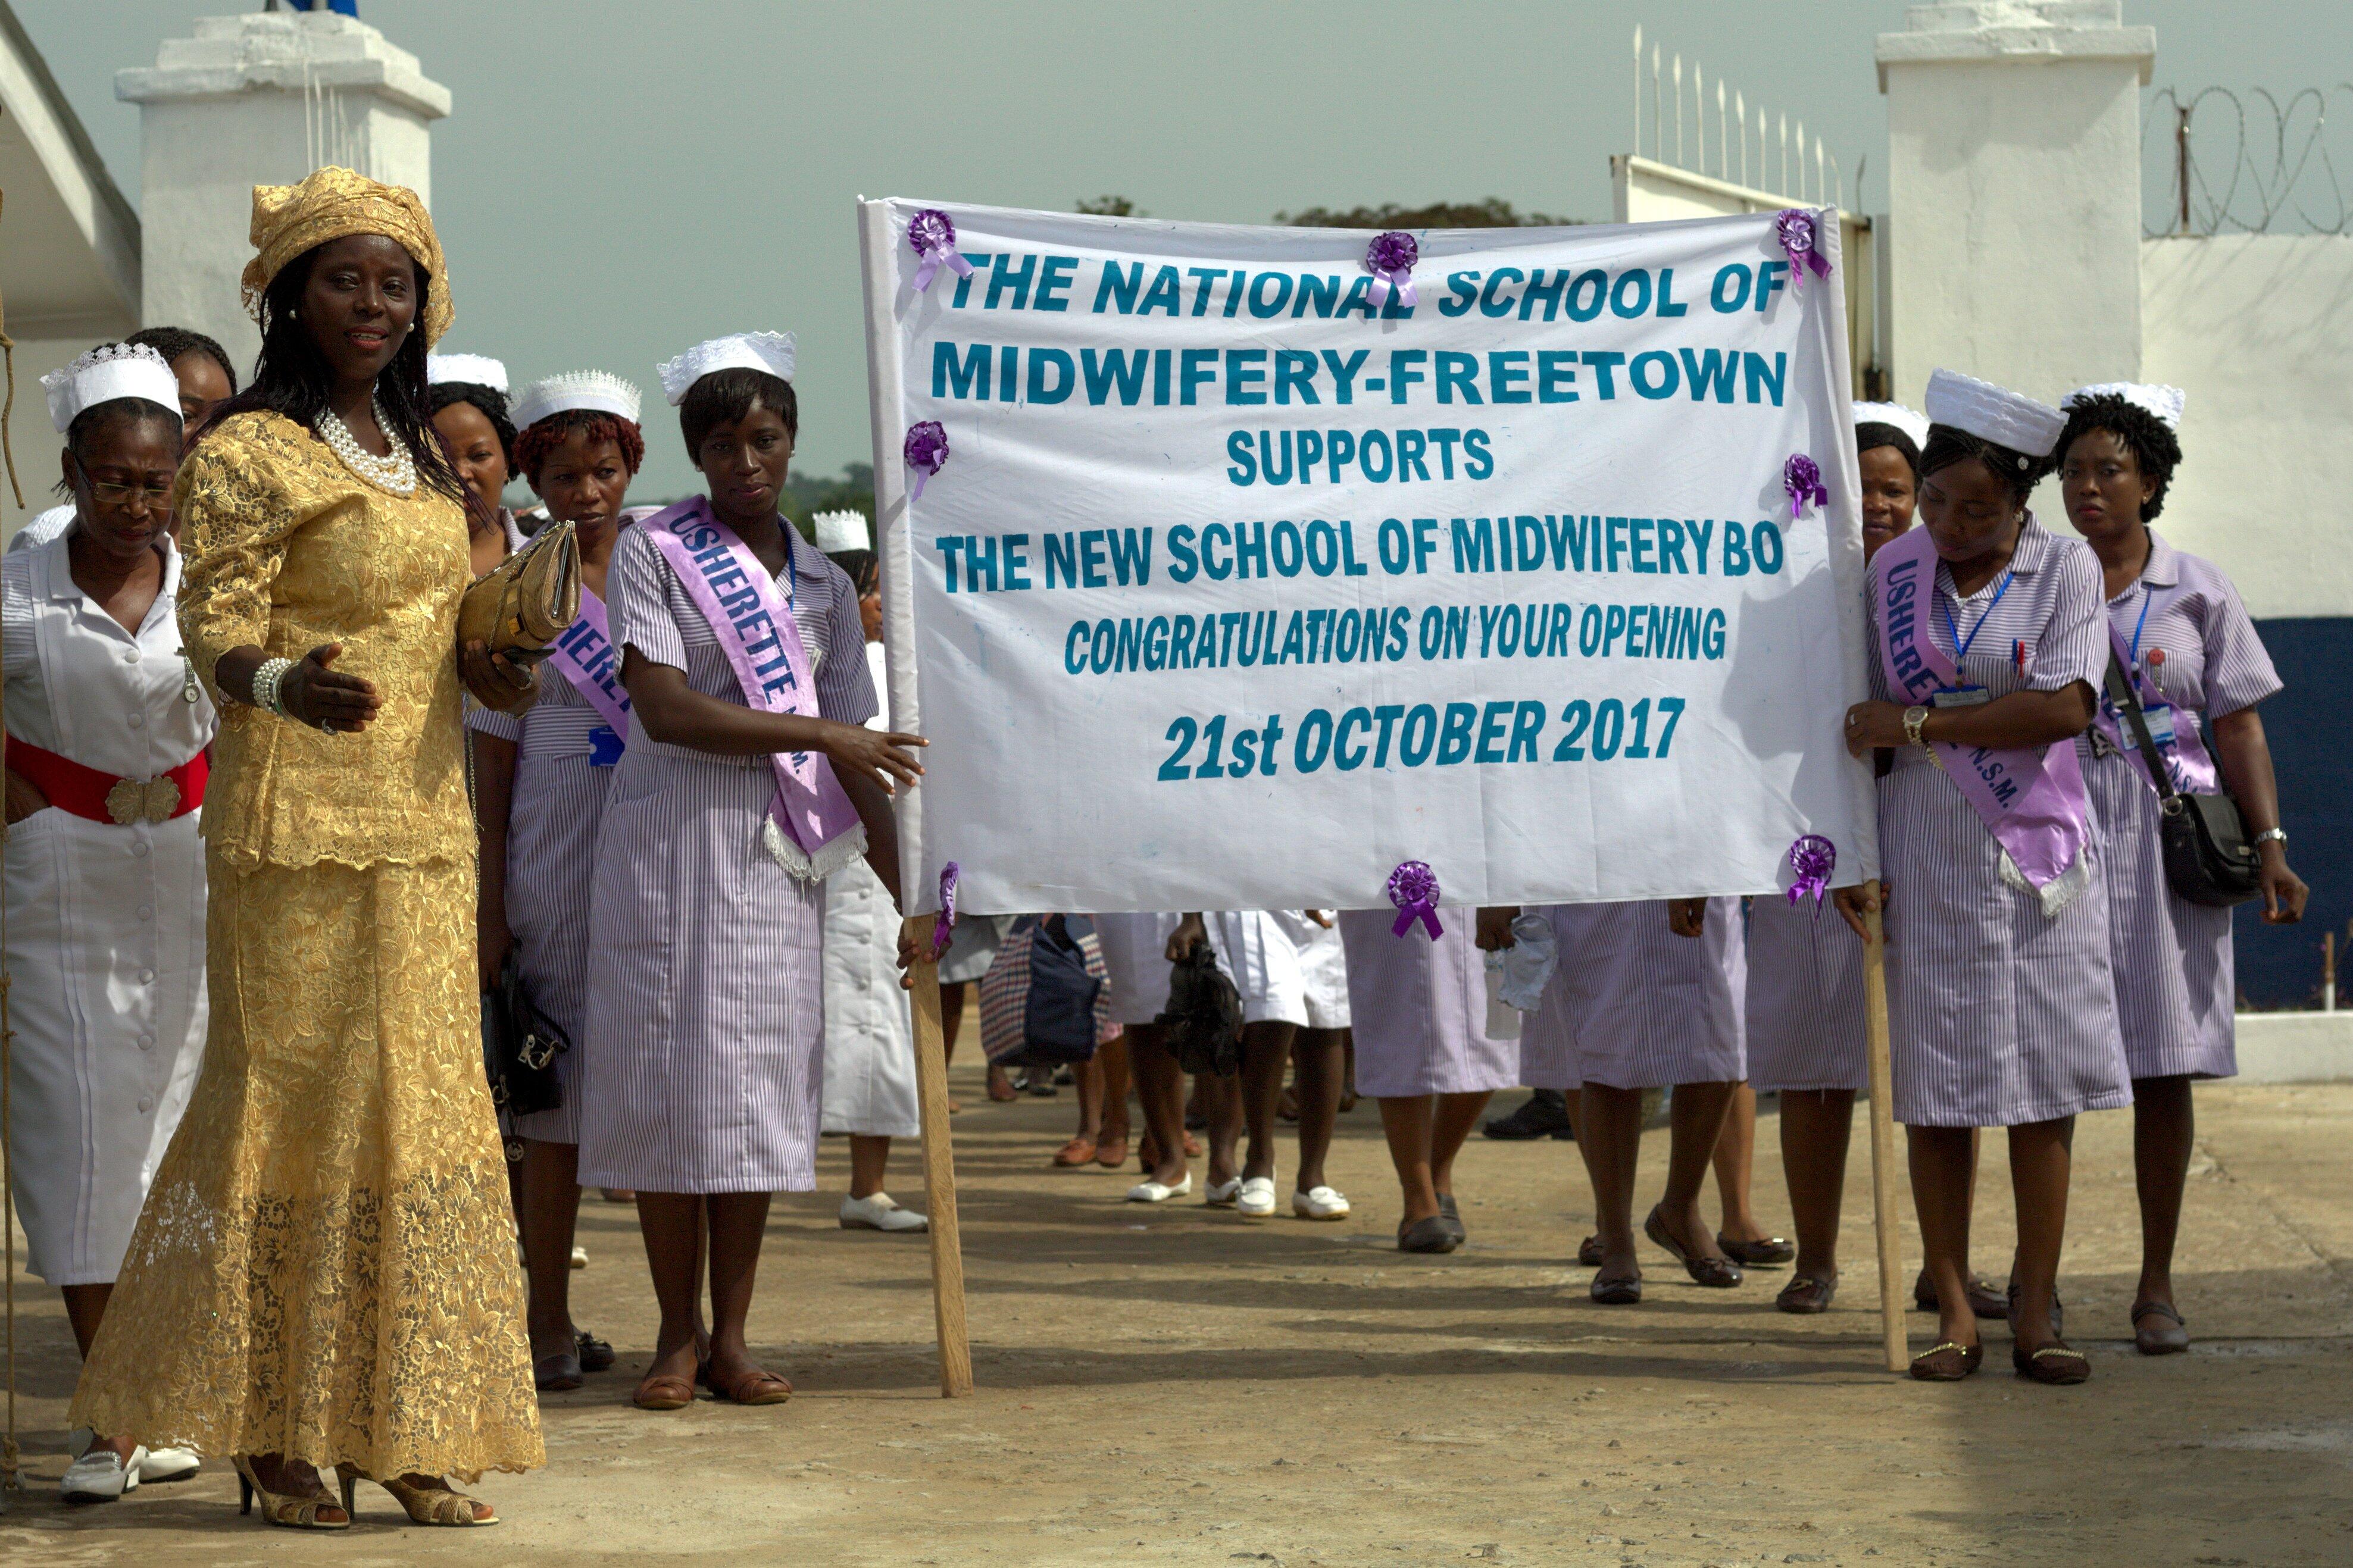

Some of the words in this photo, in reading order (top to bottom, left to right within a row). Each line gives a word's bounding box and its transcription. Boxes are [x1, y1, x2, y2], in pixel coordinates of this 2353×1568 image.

[952, 253, 1079, 312] THE
[1093, 261, 1415, 320] NATIONAL
[1438, 268, 1688, 323] SCHOOL
[1710, 261, 1789, 314] OF
[932, 342, 1787, 407] MIDWIFERY-FREETOWN
[1227, 428, 1494, 487] SUPPORTS
[936, 533, 1032, 593] THE
[1043, 527, 1152, 589] NEW
[1167, 518, 1368, 586] SCHOOL
[1378, 518, 1438, 575] OF
[1451, 514, 1714, 575] MIDWIFERY
[1723, 520, 1783, 577] BO
[668, 510, 797, 705] USHERETTE
[1064, 606, 1411, 675] CONGRATULATIONS
[1419, 605, 1470, 661] ON
[1479, 603, 1572, 658] YOUR
[1579, 603, 1726, 661] OPENING
[1157, 714, 1283, 781] 21st
[1294, 700, 1546, 774] OCTOBER
[1552, 697, 1686, 762] 2017
[1968, 747, 2018, 809] N.S.M.
